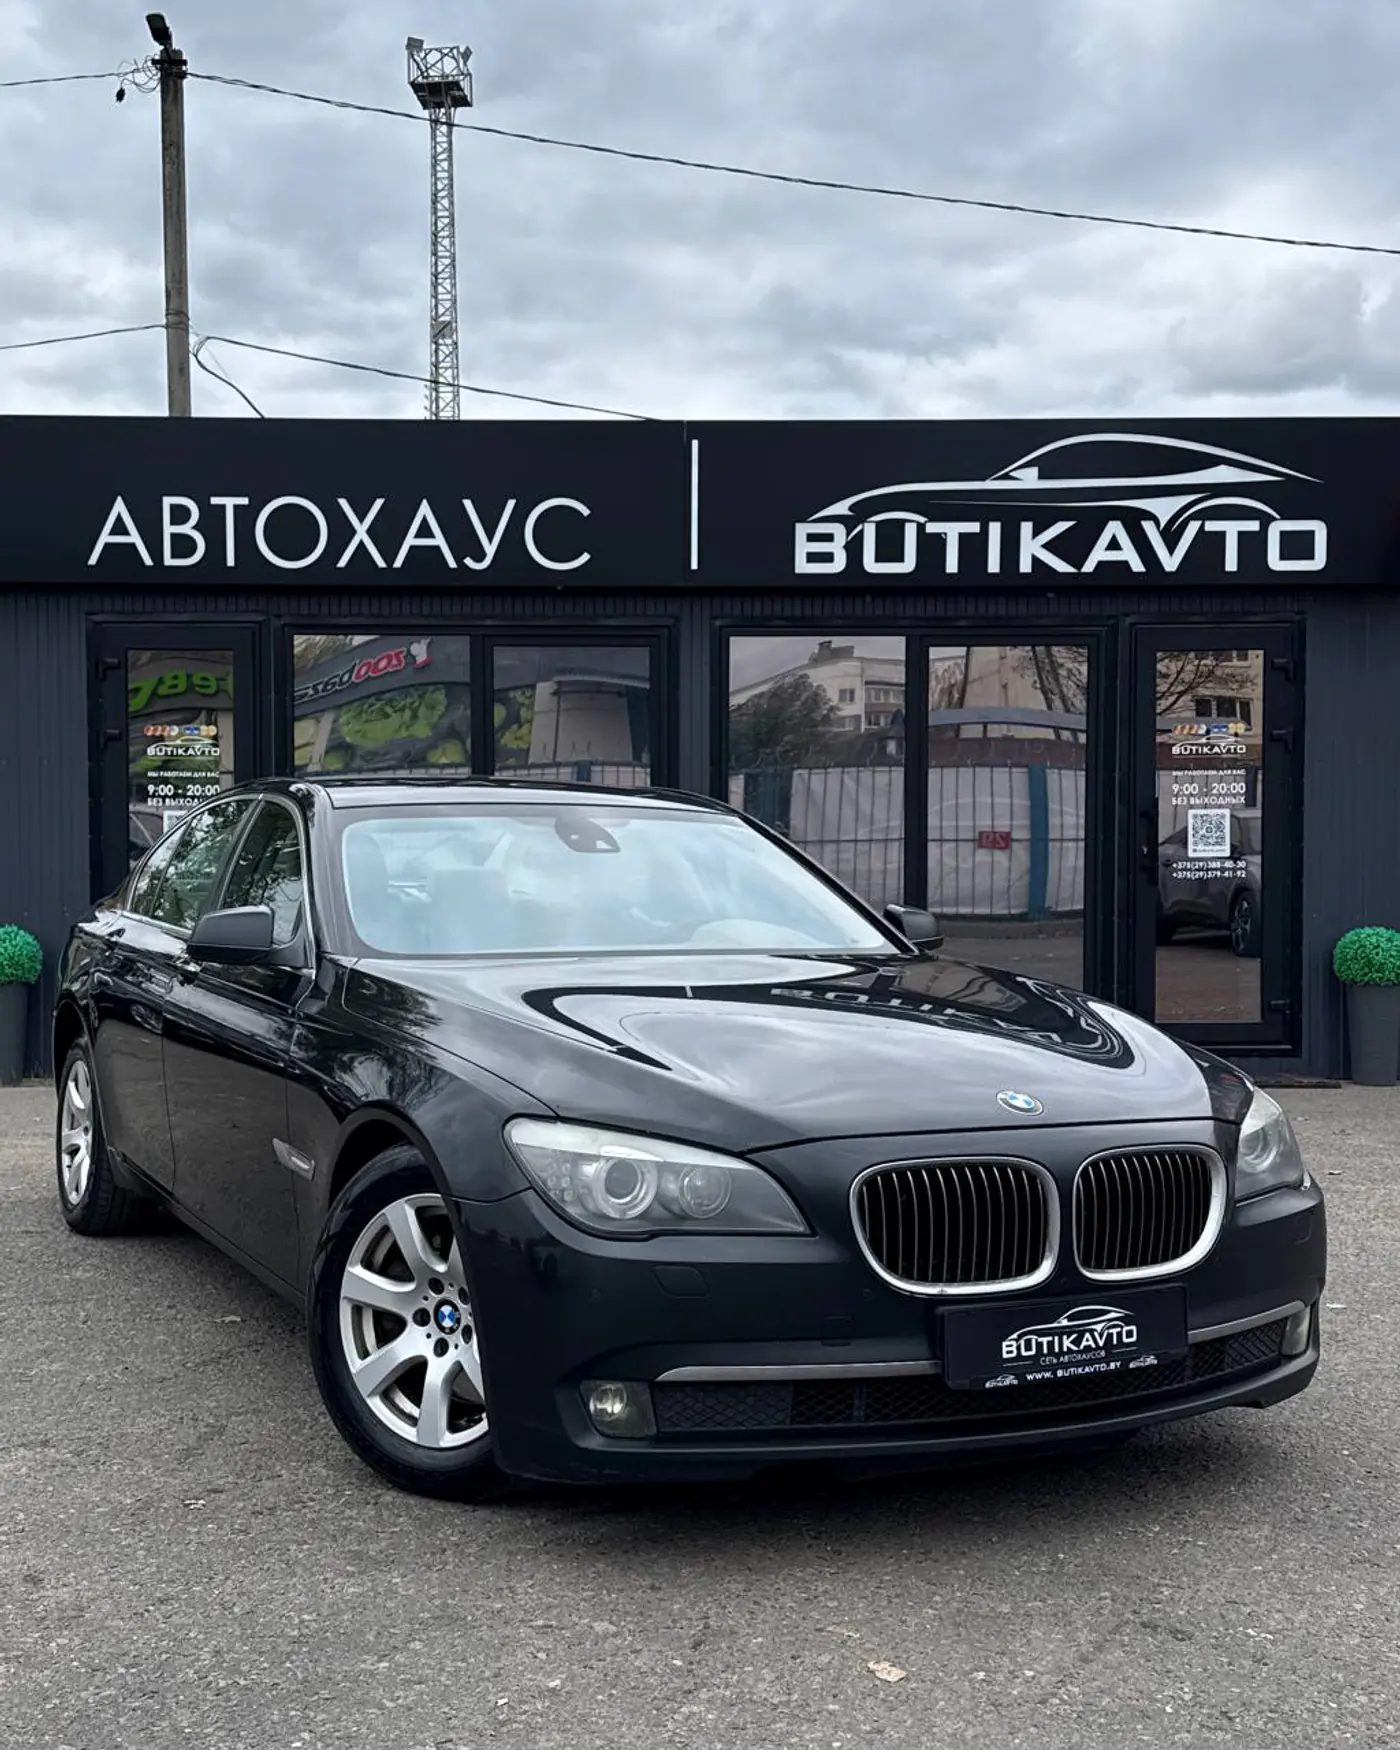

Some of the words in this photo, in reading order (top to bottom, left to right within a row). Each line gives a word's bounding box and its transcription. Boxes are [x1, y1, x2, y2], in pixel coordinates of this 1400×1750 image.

[88, 496, 591, 571] АВТОХАУС
[794, 519, 1328, 575] BUTIKAVTO
[147, 747, 220, 756] BUTIKAVTO
[1171, 745, 1246, 754] BUTIKAVTO
[147, 784, 174, 796] 9:00
[186, 784, 220, 796] 20:00
[1172, 783, 1199, 795] 9:00
[1211, 782, 1246, 794] 20:00
[1172, 796, 1188, 806] БЕЗ
[1189, 795, 1246, 805] ВЫХОДНЫХ
[1001, 1324, 1138, 1359] BUTIKAVTO
[1026, 1371, 1054, 1381] WWW.
[1056, 1361, 1121, 1378] BUTIKAVTO.BY
